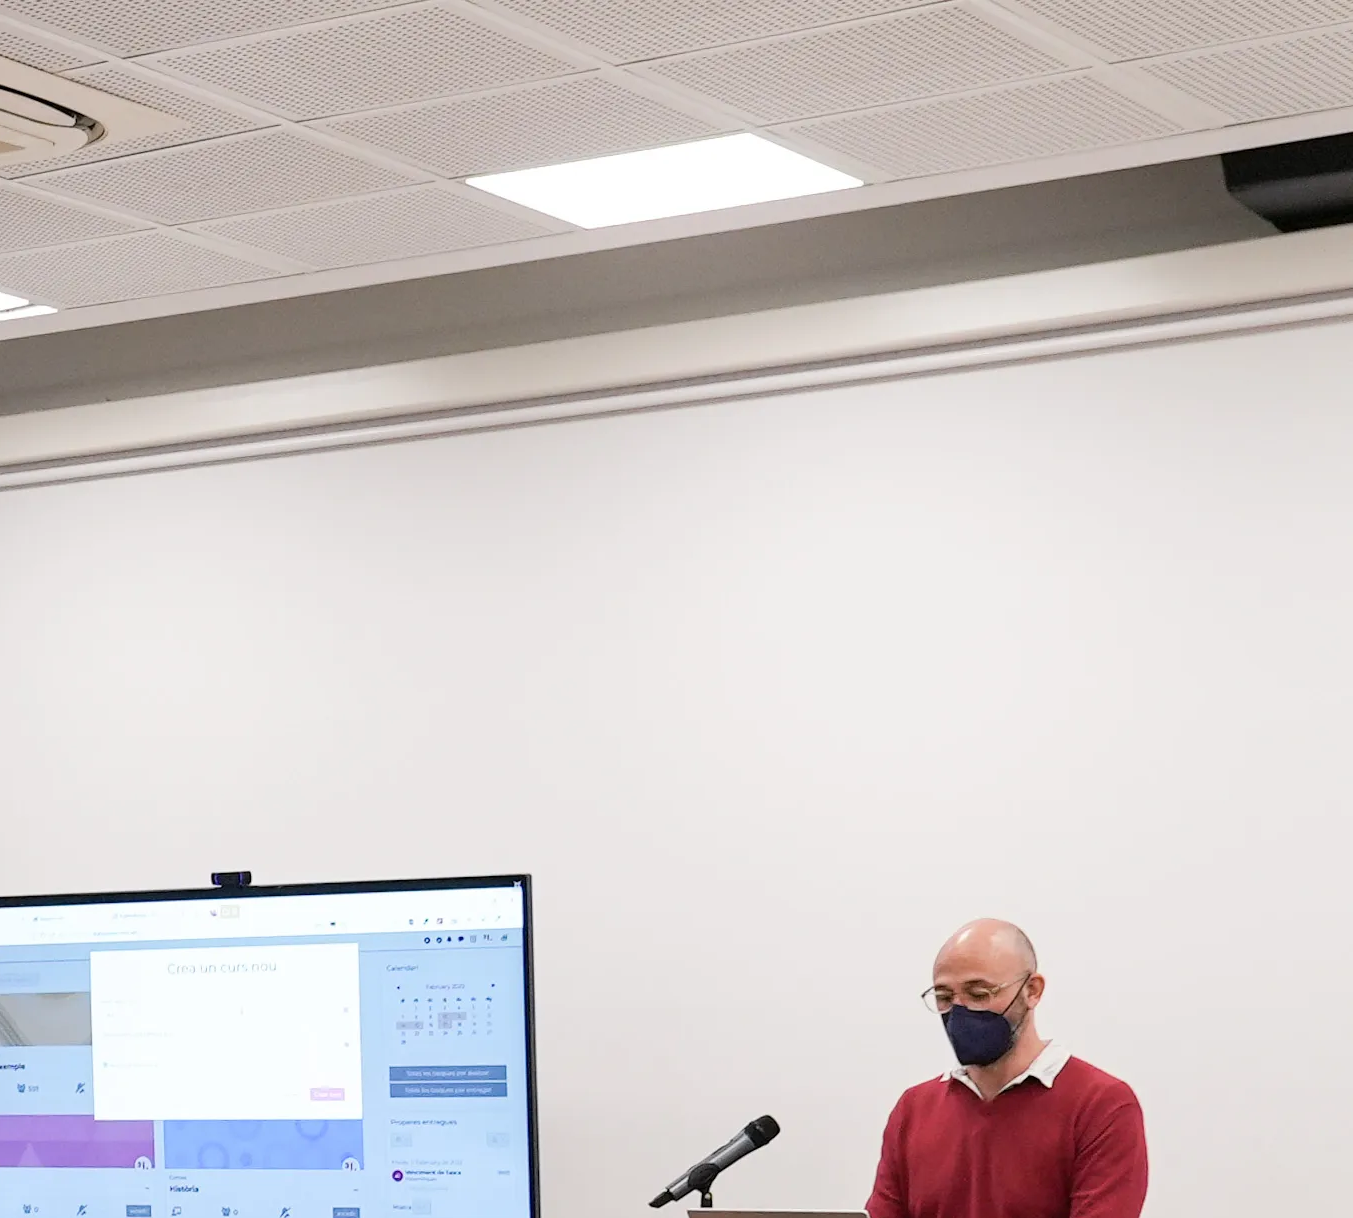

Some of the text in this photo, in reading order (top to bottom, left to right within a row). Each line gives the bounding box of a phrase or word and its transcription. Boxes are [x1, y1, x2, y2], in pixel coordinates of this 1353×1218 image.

[167, 961, 278, 975] Crea un curs nou
